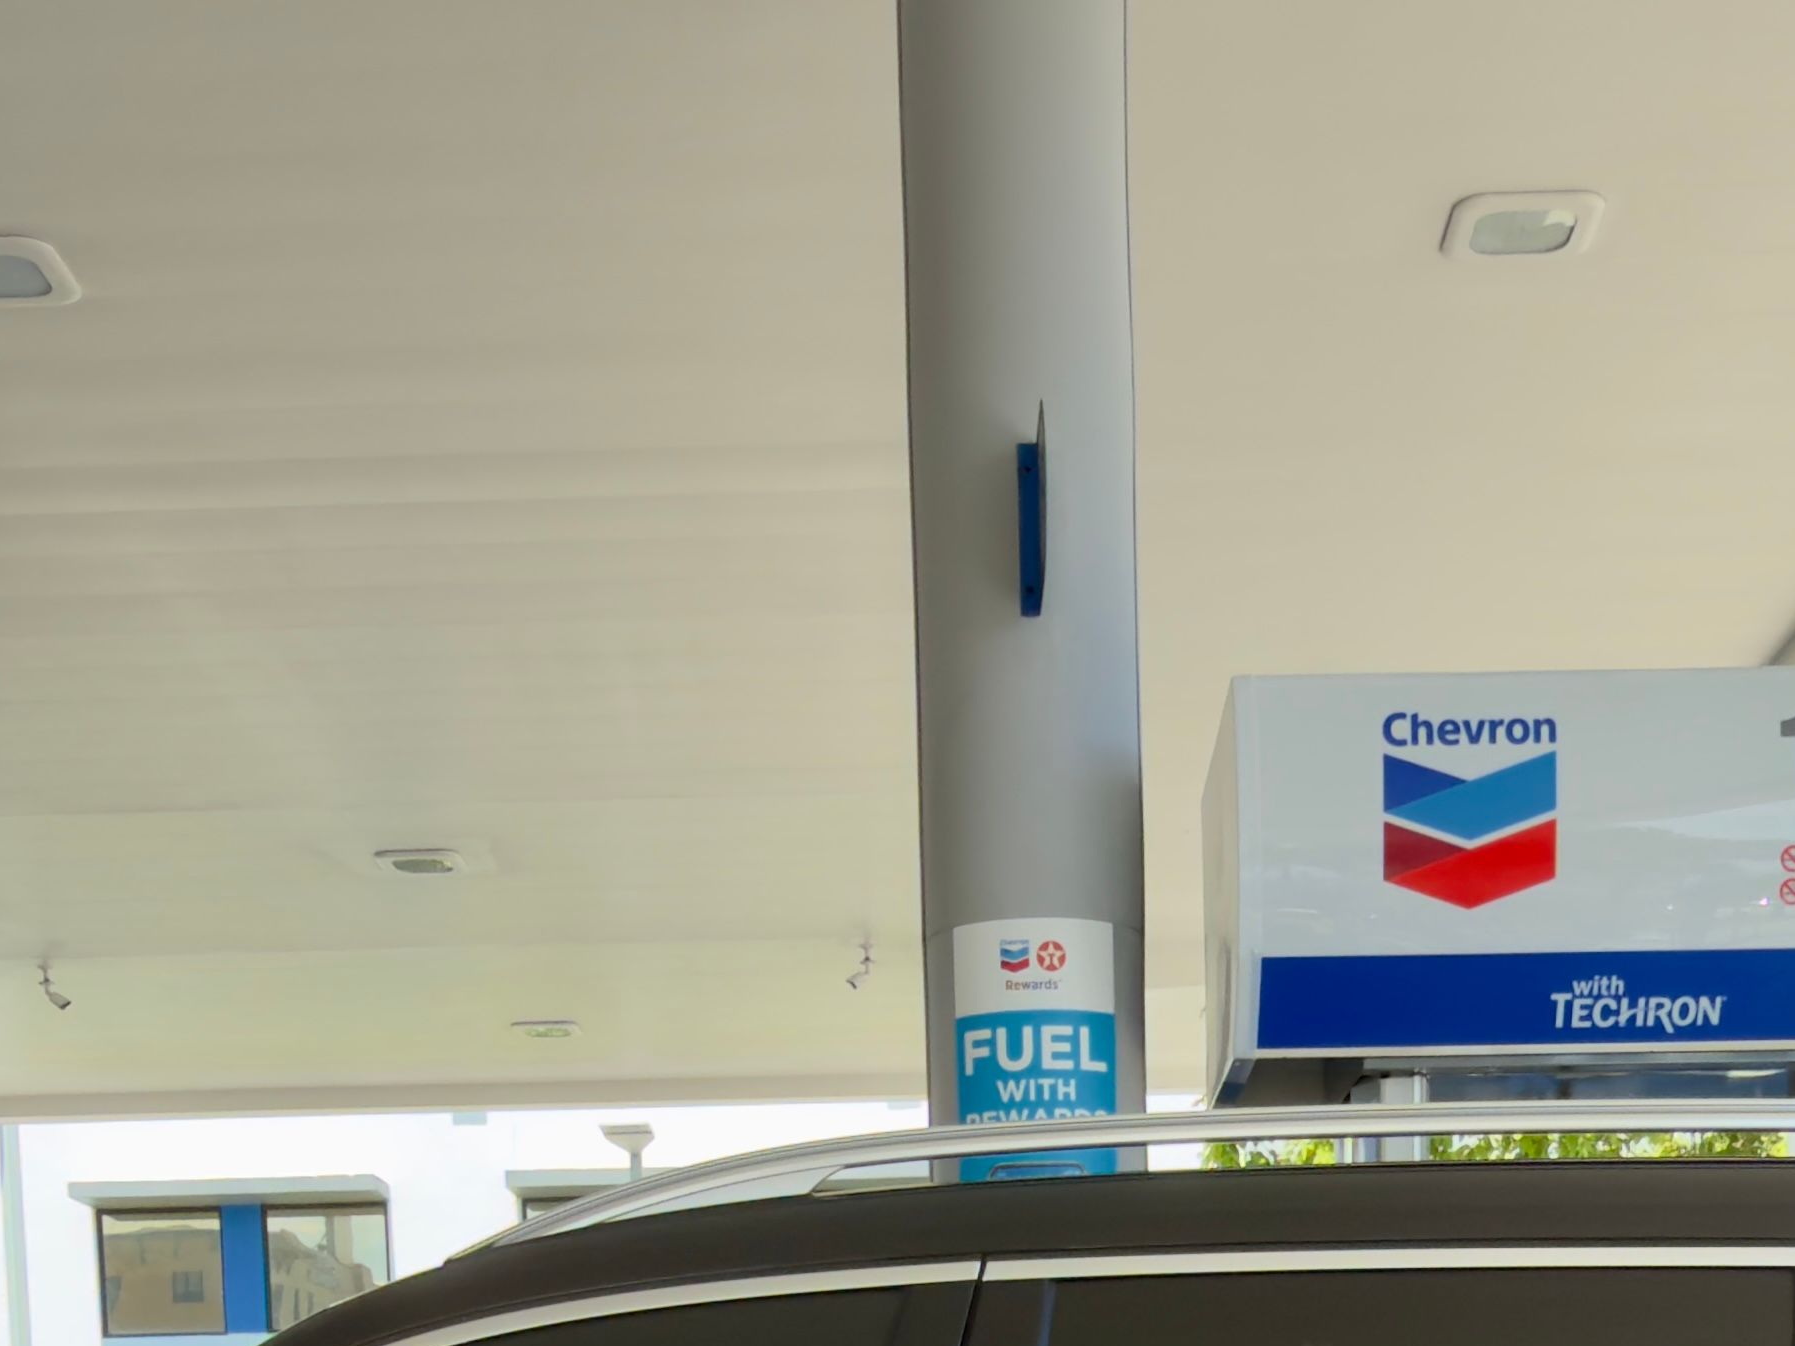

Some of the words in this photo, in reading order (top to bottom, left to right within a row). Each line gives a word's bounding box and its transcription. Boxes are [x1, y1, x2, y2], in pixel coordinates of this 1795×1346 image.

[1382, 712, 1557, 746] Chevron
[1005, 979, 1058, 991] Rewards
[1572, 974, 1625, 997] with
[1550, 993, 1724, 1034] TECHRON
[963, 1025, 1108, 1076] FUEL
[996, 1079, 1076, 1102] WITH
[965, 1108, 1108, 1124] REWAR
